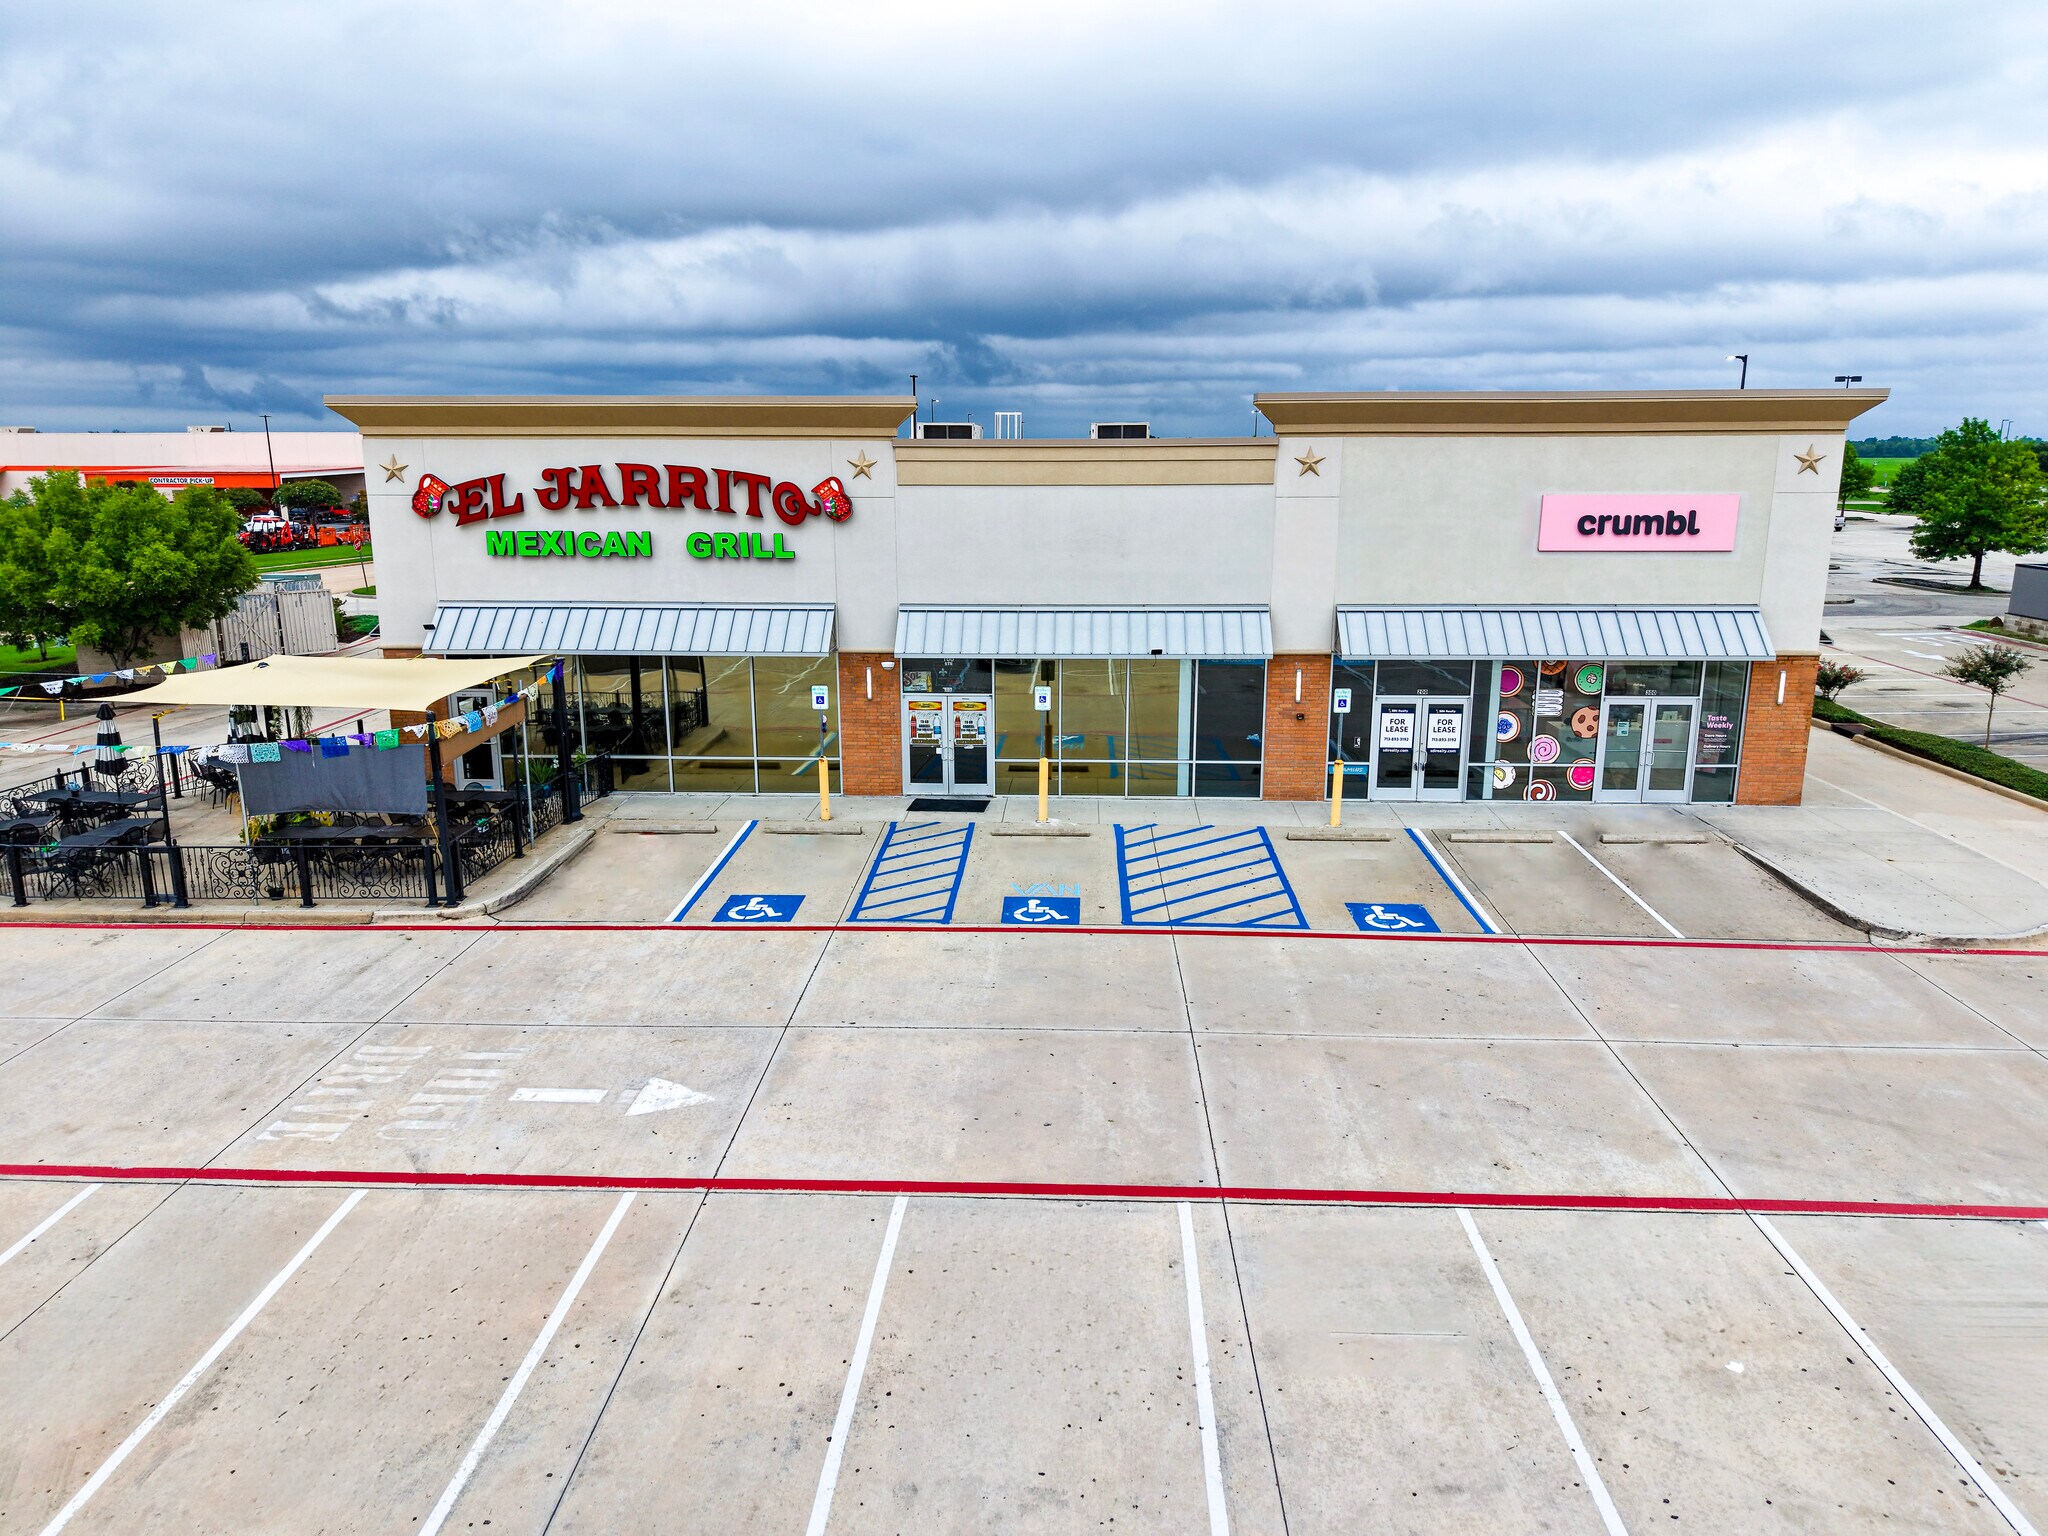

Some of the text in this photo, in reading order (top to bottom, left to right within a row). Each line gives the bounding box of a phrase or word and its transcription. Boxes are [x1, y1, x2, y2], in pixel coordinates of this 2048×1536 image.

[448, 462, 822, 527] EL JARRITO
[1577, 510, 1700, 536] crumbl
[486, 531, 795, 558] MEXICAN GRILL
[1706, 722, 1734, 730] Weekly
[1707, 714, 1728, 722] Taste
[1009, 882, 1081, 896] VAN
[254, 1045, 433, 1142] DRIVE
